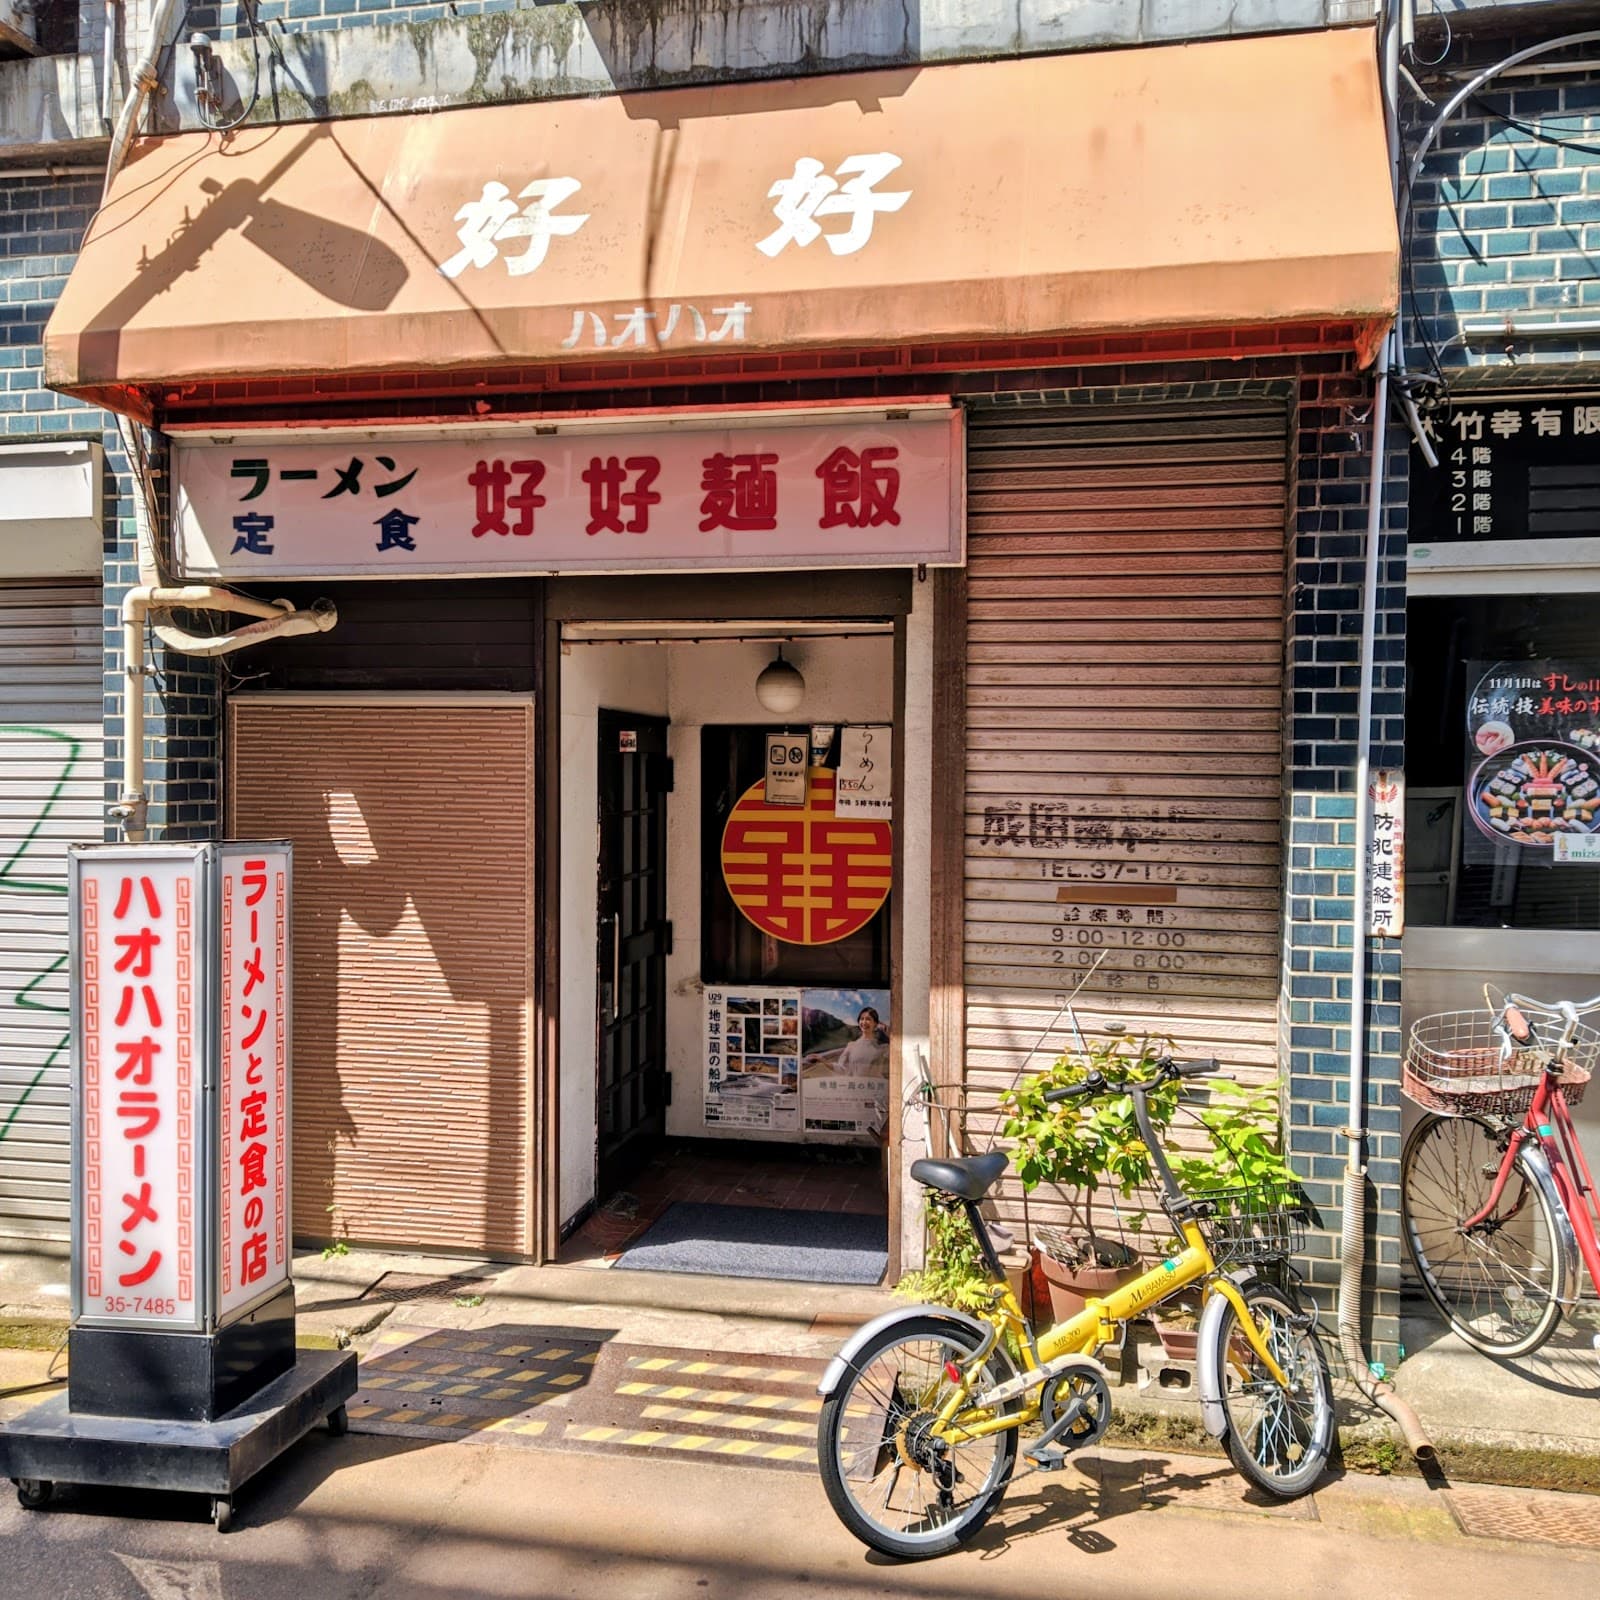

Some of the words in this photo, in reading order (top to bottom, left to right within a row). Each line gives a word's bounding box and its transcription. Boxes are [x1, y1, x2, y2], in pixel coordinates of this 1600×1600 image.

[561, 301, 752, 348] ハオハオ
[230, 455, 420, 501] ラーメン
[467, 445, 903, 537] 好好麺飯
[859, 731, 874, 792] らーめん
[1372, 812, 1394, 926] 防犯連絡所
[113, 876, 163, 1287] ハオハオラーメン
[240, 860, 268, 1286] ラーメンと定食の店
[105, 1296, 176, 1315] 35-7485
